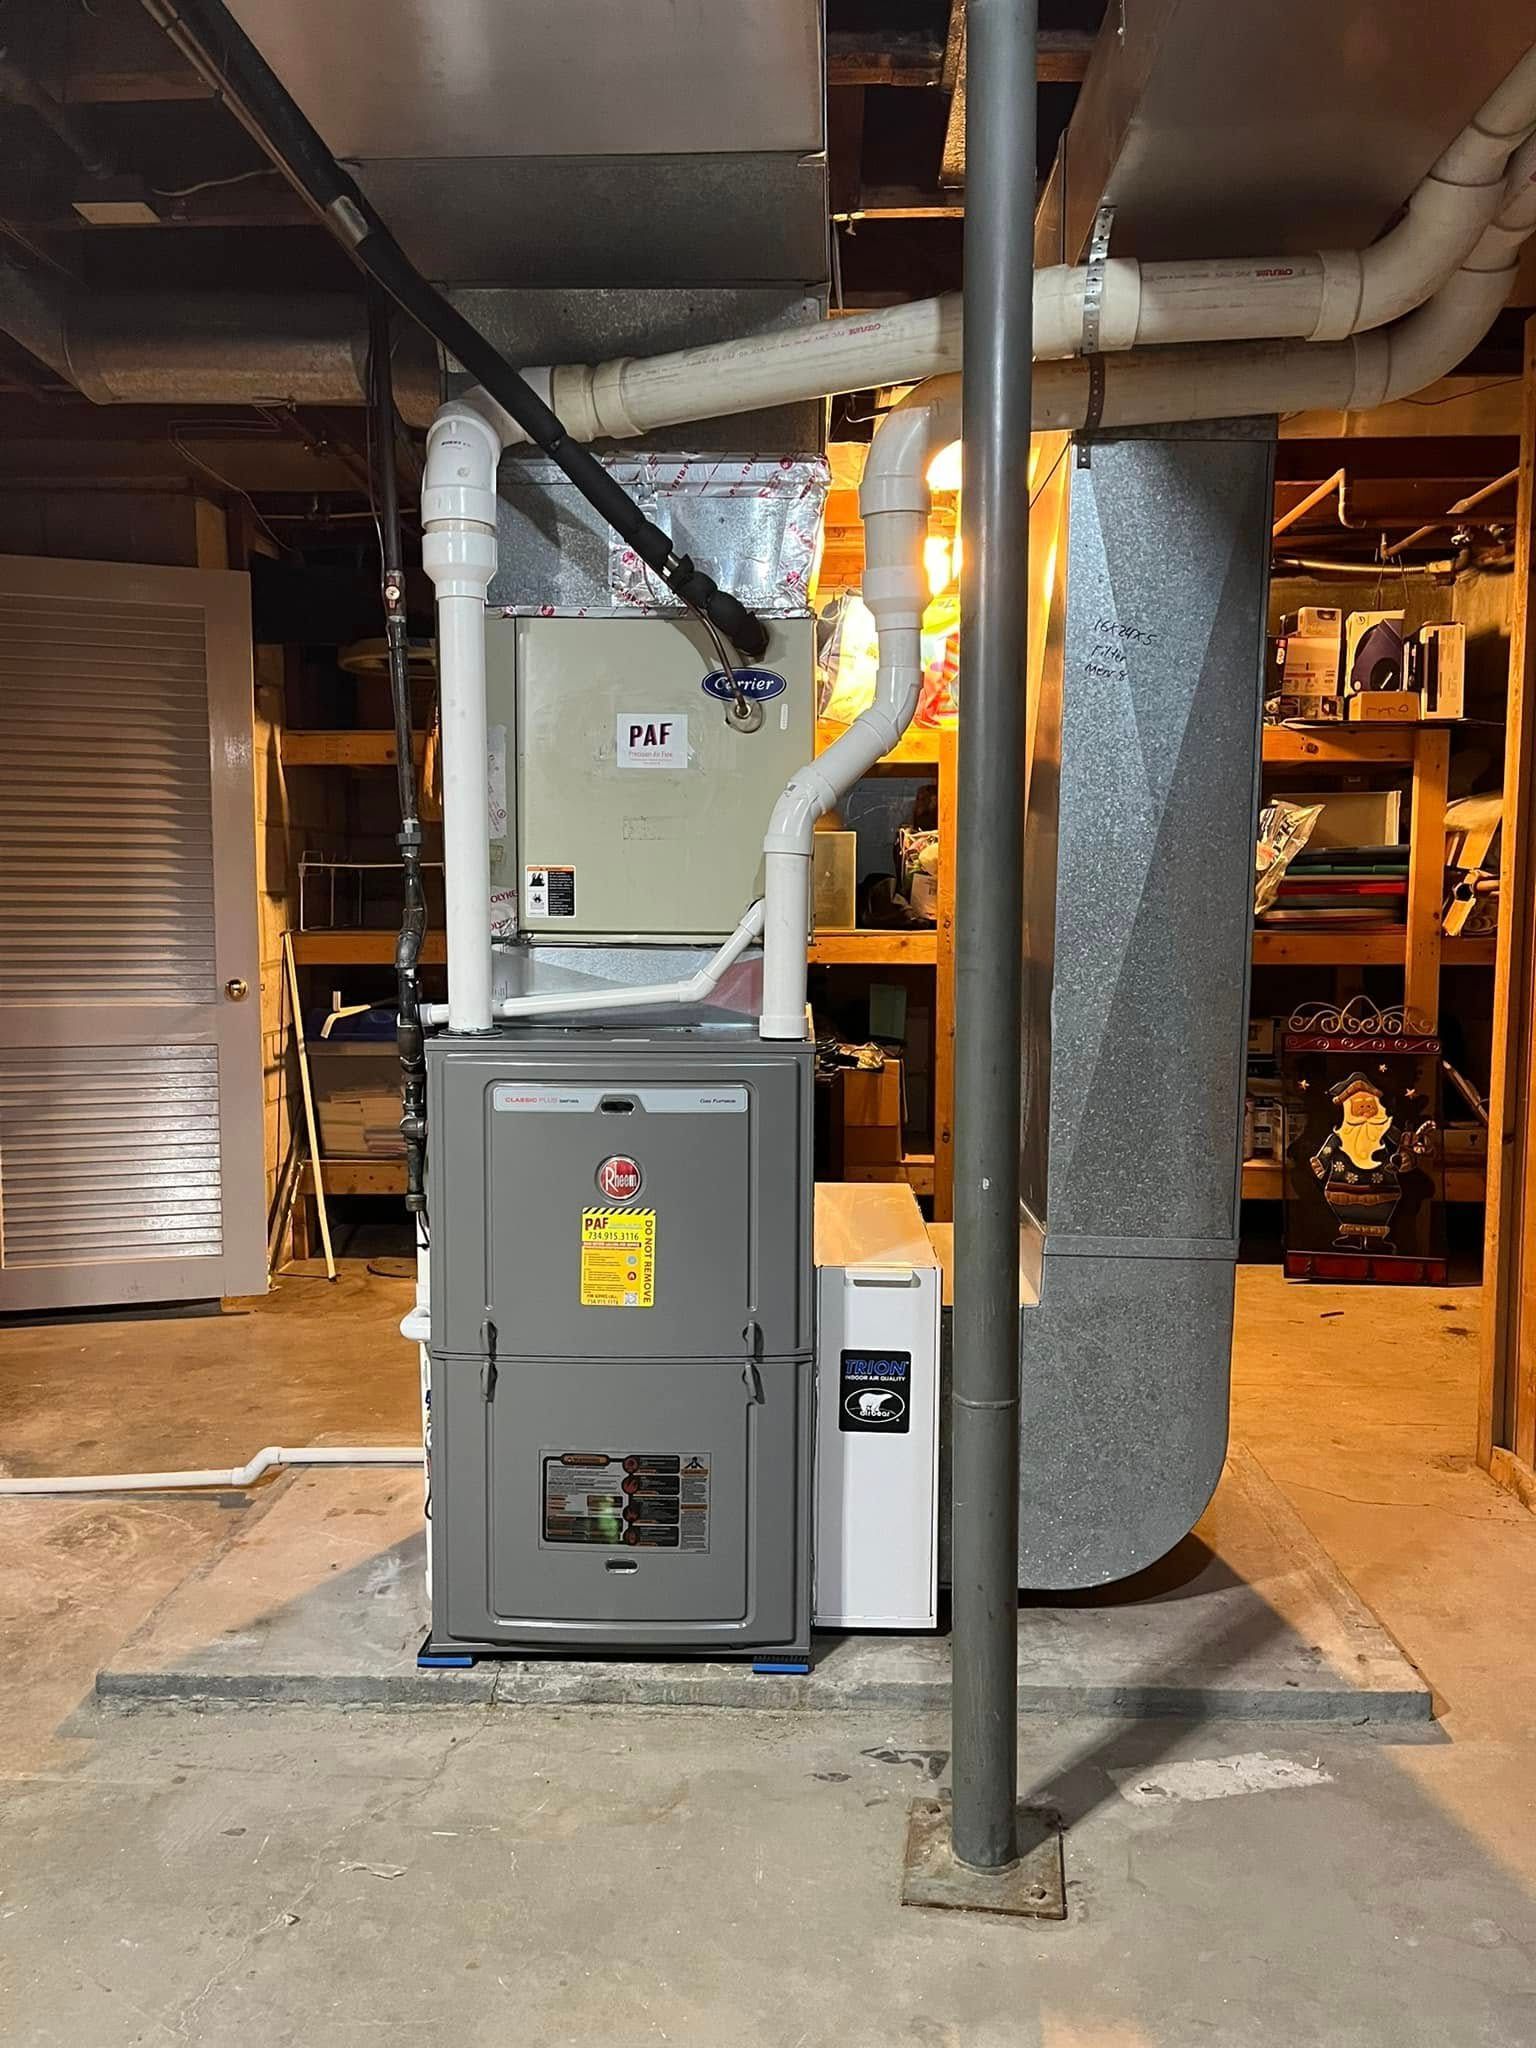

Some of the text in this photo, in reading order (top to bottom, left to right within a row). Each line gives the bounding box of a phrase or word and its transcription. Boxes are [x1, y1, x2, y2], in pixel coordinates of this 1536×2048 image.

[629, 722, 673, 747] PAF
[605, 1161, 637, 1192] Rheem
[585, 1217, 608, 1231] PAF
[588, 1231, 640, 1241] 734.915.3116
[643, 1220, 653, 1303] DO NOT REMOVE
[845, 1360, 906, 1375] TRION
